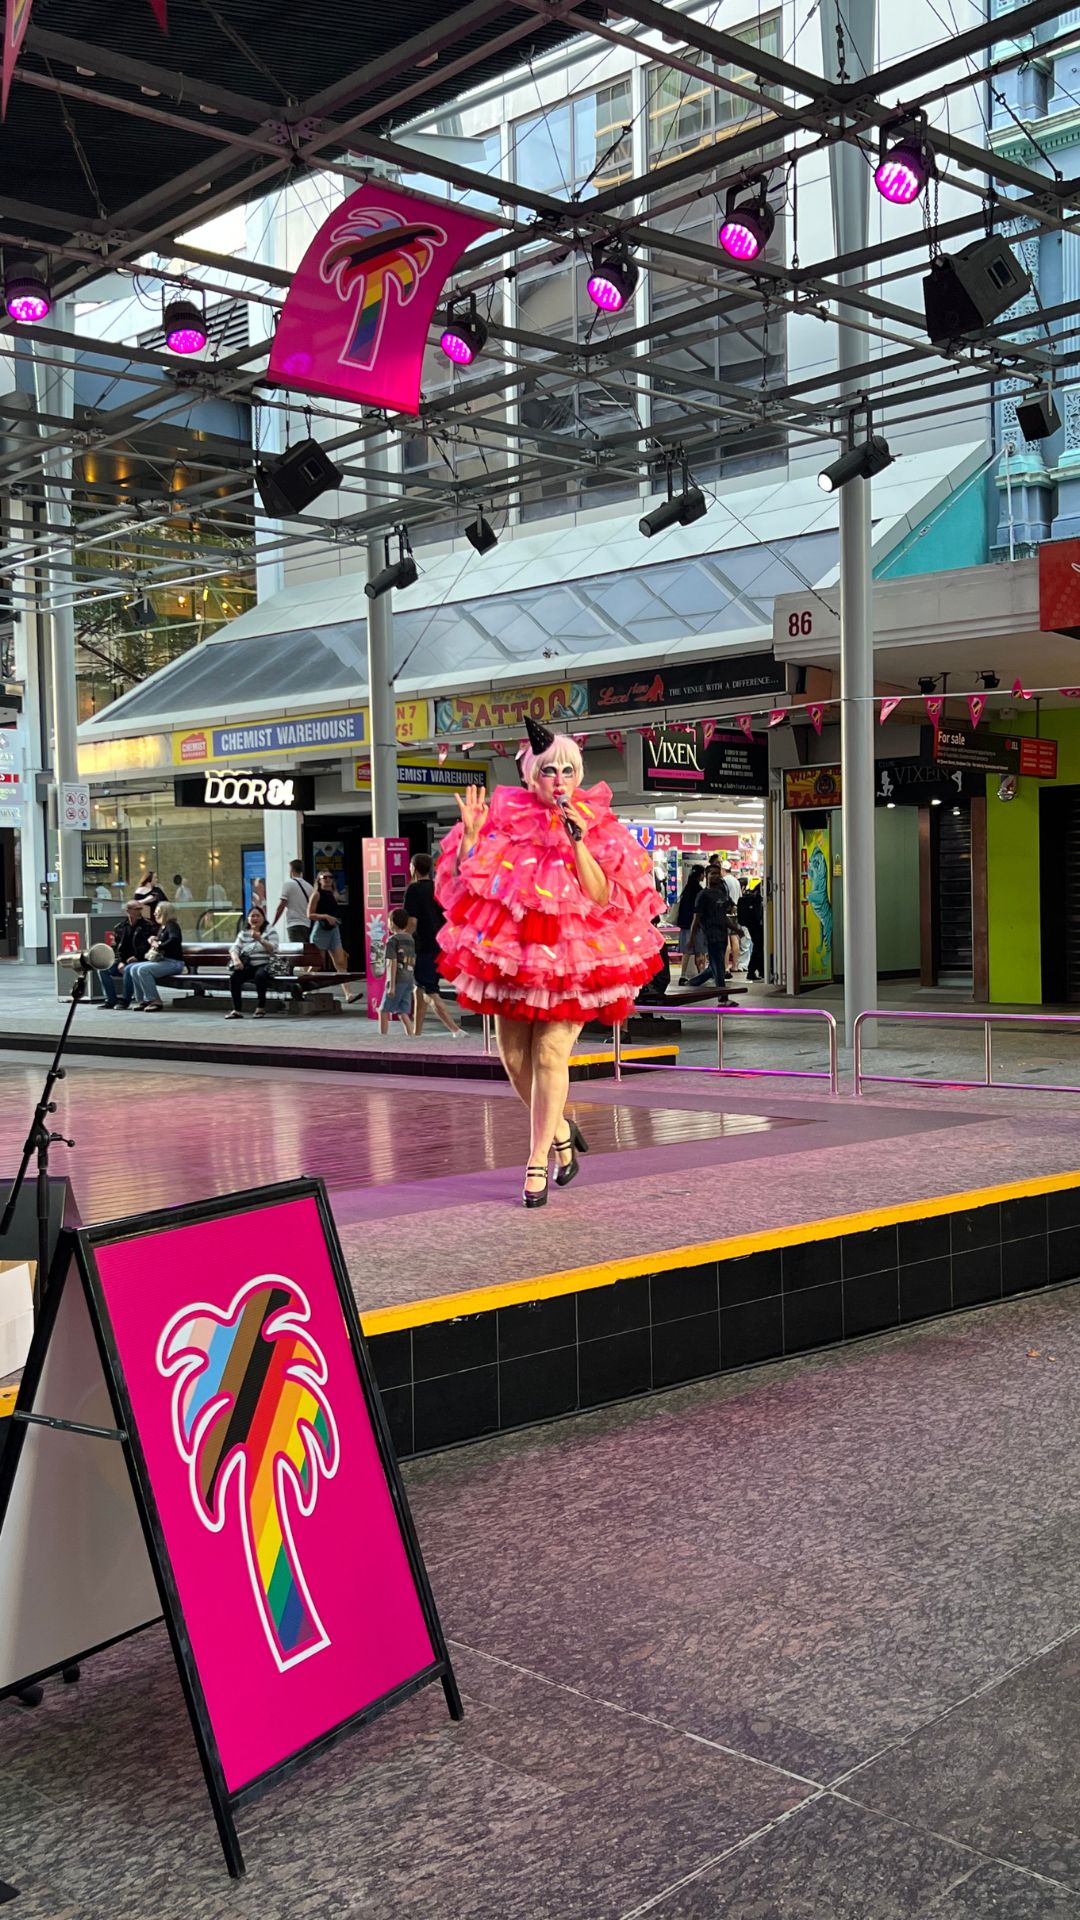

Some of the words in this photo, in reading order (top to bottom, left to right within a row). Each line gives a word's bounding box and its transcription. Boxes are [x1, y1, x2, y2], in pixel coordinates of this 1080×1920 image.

[788, 610, 812, 637] 86
[669, 687, 681, 697] THE
[683, 685, 704, 695] VENUE
[705, 682, 723, 692] WITH
[725, 680, 730, 689] A
[408, 705, 417, 719] 7
[456, 688, 566, 729] TATTOO
[221, 728, 273, 752] CHEMIST
[276, 718, 355, 745] WAREHOUSE
[938, 731, 950, 743] For
[951, 732, 966, 745] sale
[648, 736, 705, 772] VIXEN
[396, 767, 427, 782] EMIST
[430, 770, 484, 785] WAREHOUSE
